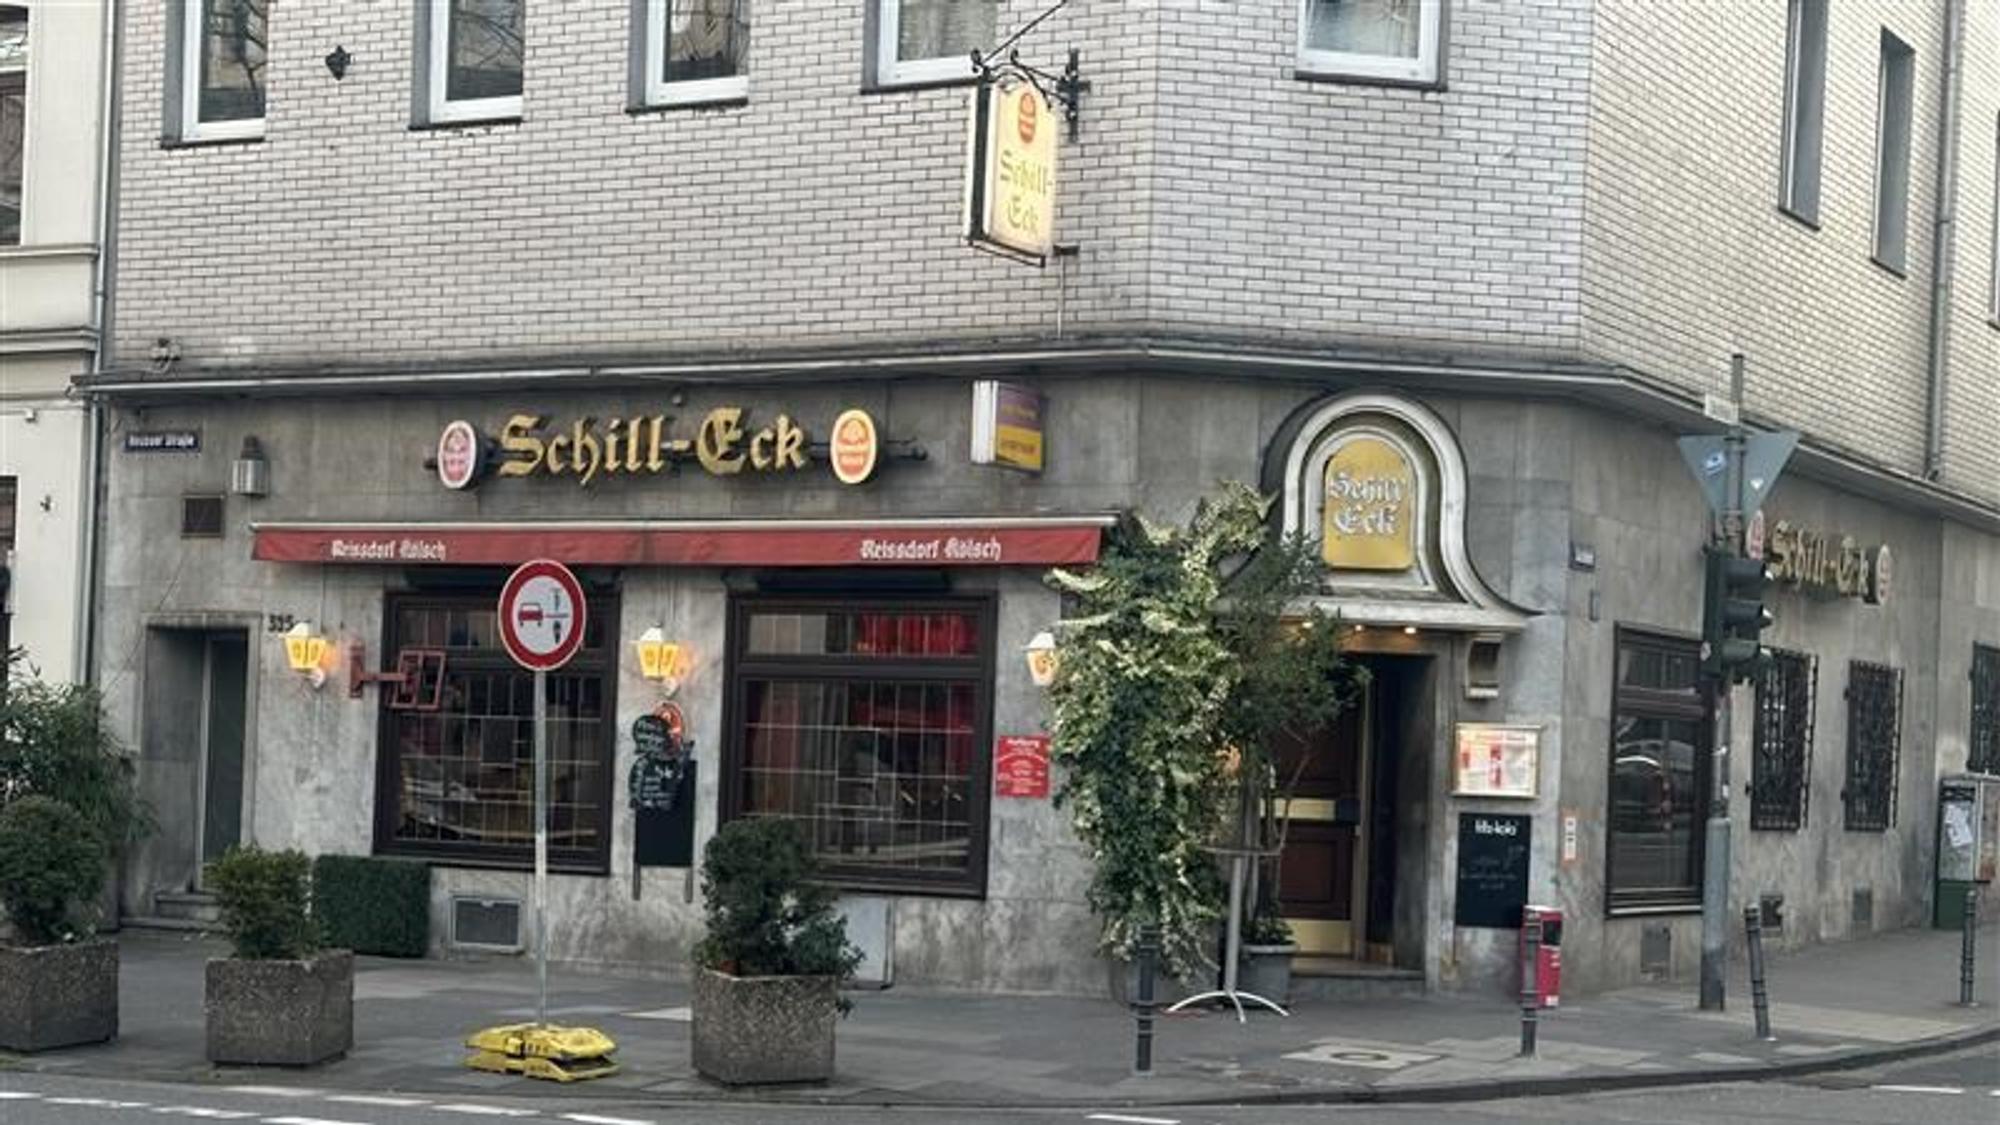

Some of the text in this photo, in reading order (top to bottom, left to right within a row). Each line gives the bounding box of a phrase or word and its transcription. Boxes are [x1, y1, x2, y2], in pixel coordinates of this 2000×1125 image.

[1007, 195, 1040, 235] Eck
[500, 407, 805, 485] Schill-Eck
[1334, 503, 1399, 535] Eck
[331, 539, 447, 561] Reissdorf Kölsch
[860, 536, 1002, 562] Reissdorf Kölsch
